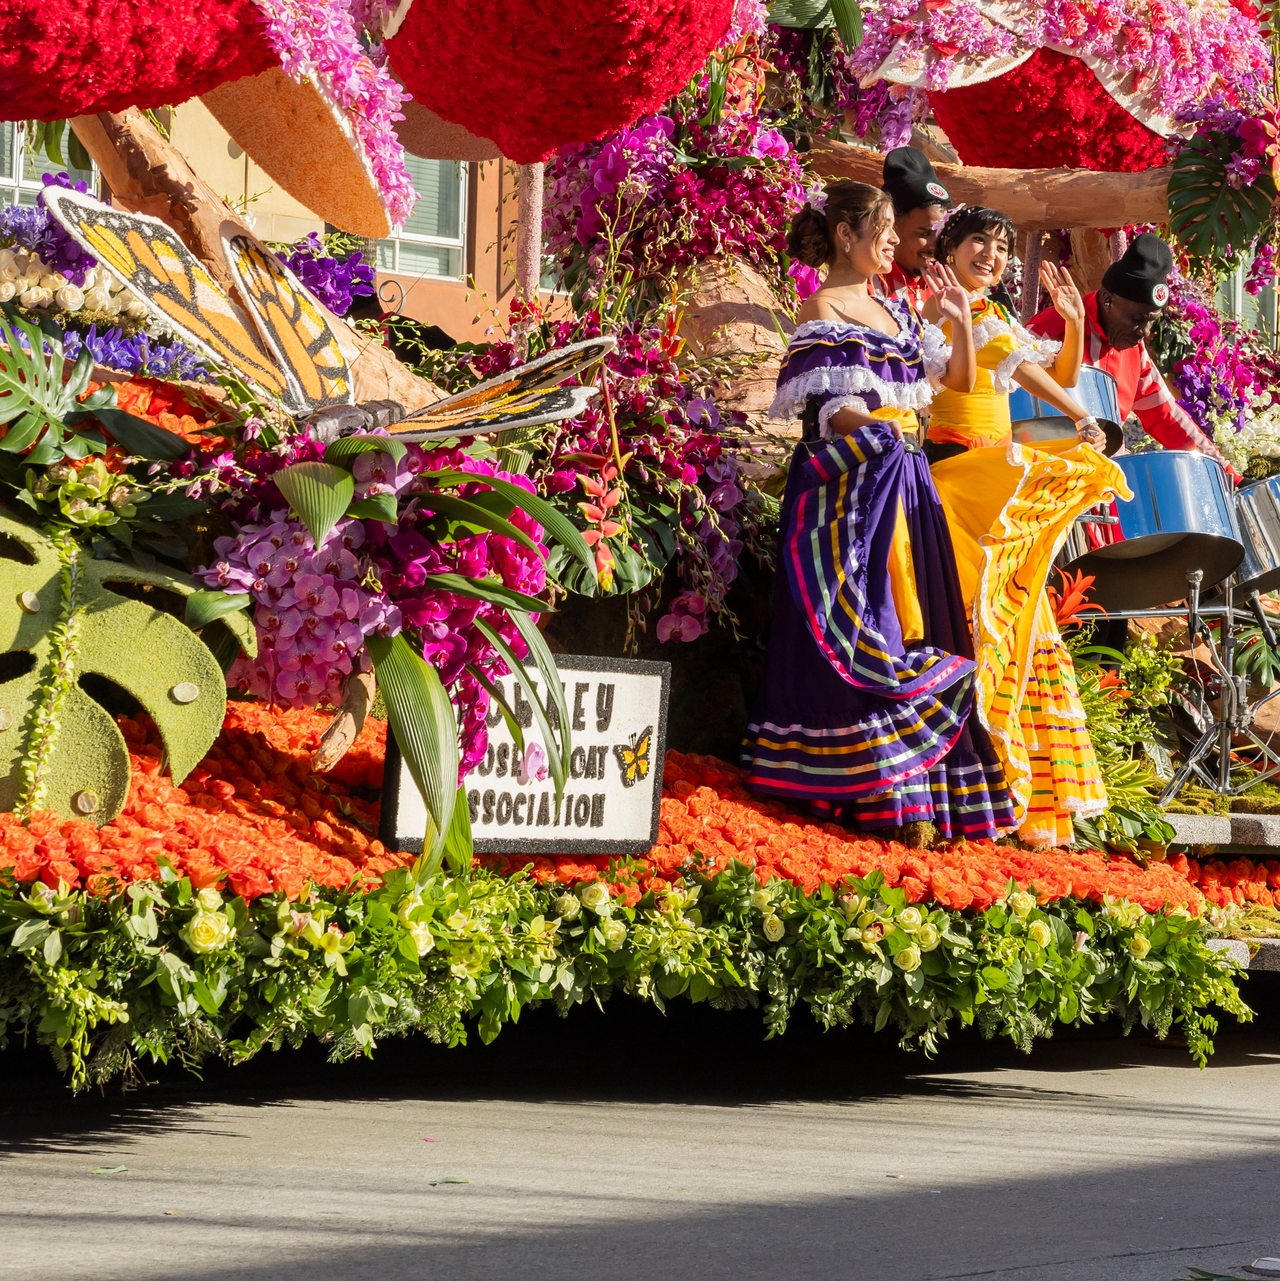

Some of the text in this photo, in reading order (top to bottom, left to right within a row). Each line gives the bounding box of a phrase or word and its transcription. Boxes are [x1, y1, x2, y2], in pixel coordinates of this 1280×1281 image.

[470, 742, 609, 780] OSE OAT
[468, 788, 606, 828] SSOCIATION
